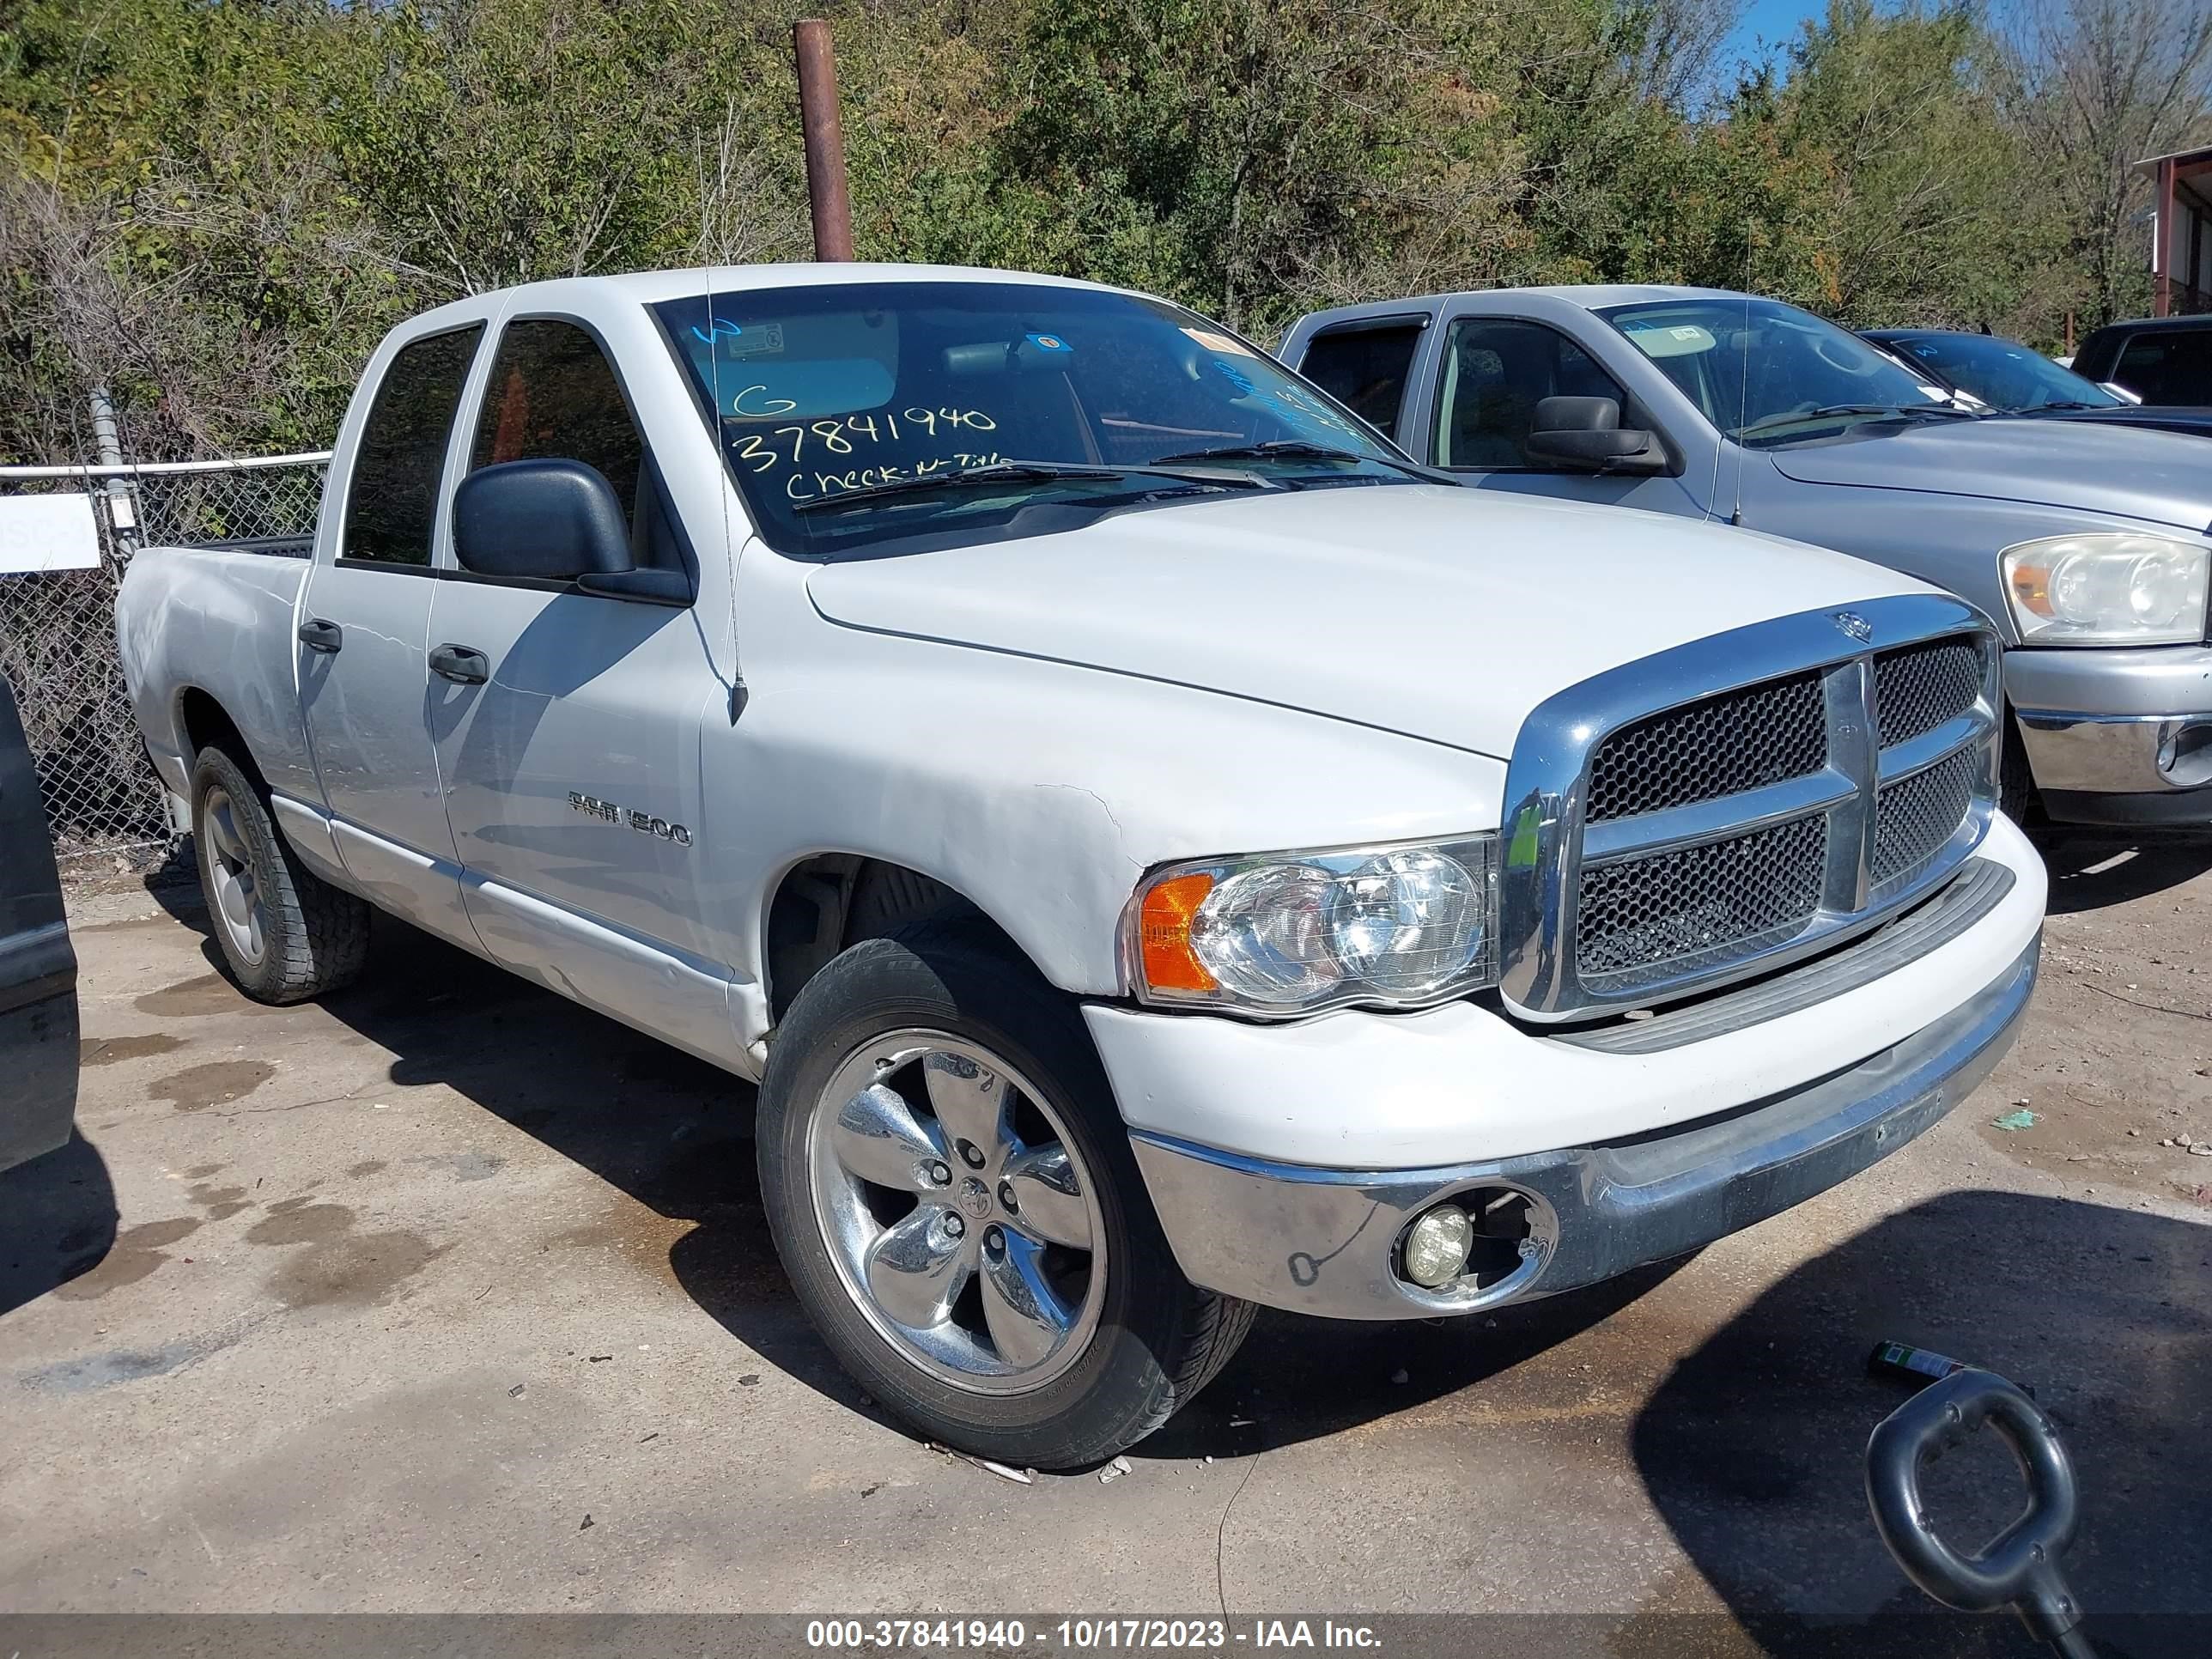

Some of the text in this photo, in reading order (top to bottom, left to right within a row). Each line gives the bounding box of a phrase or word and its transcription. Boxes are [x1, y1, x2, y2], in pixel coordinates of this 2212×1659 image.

[733, 385, 797, 417] G
[732, 407, 996, 472] 37841940
[626, 808, 694, 848] 1500
